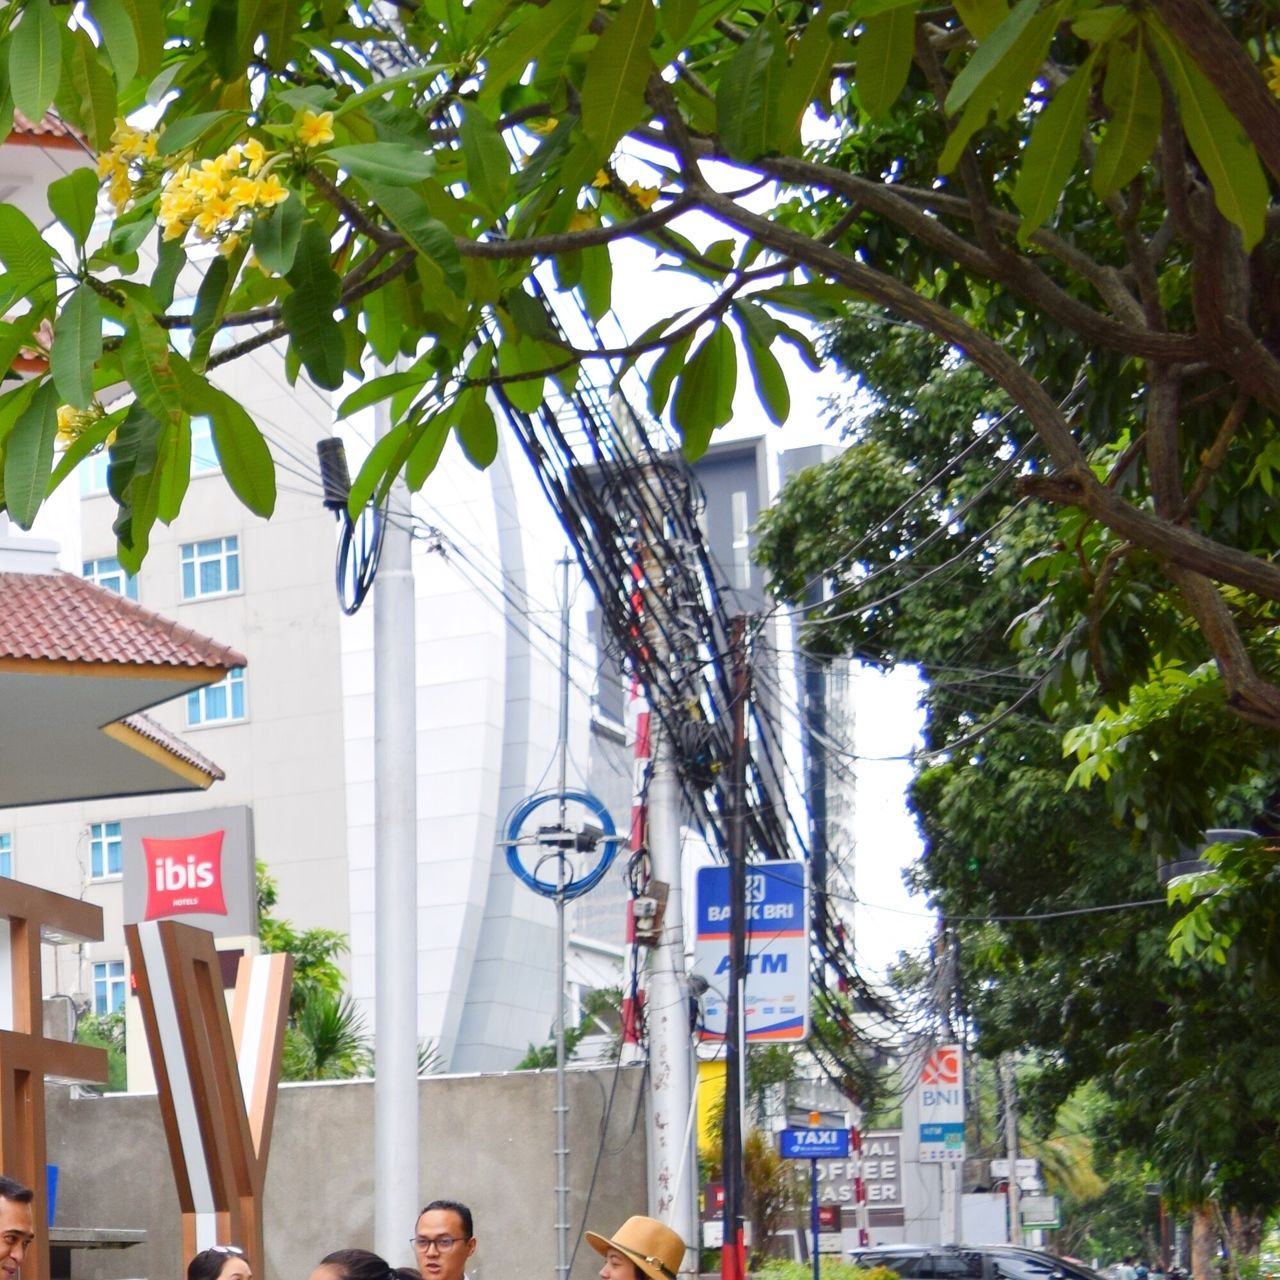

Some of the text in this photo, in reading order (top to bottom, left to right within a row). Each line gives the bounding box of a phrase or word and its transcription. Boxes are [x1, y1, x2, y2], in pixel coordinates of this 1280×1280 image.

[154, 854, 215, 892] ibis
[172, 897, 199, 907] HOTELS
[707, 903, 795, 922] BAK BRI
[922, 1090, 960, 1107] BNI
[793, 1130, 838, 1145] TAXI
[807, 1184, 897, 1203] ASER
